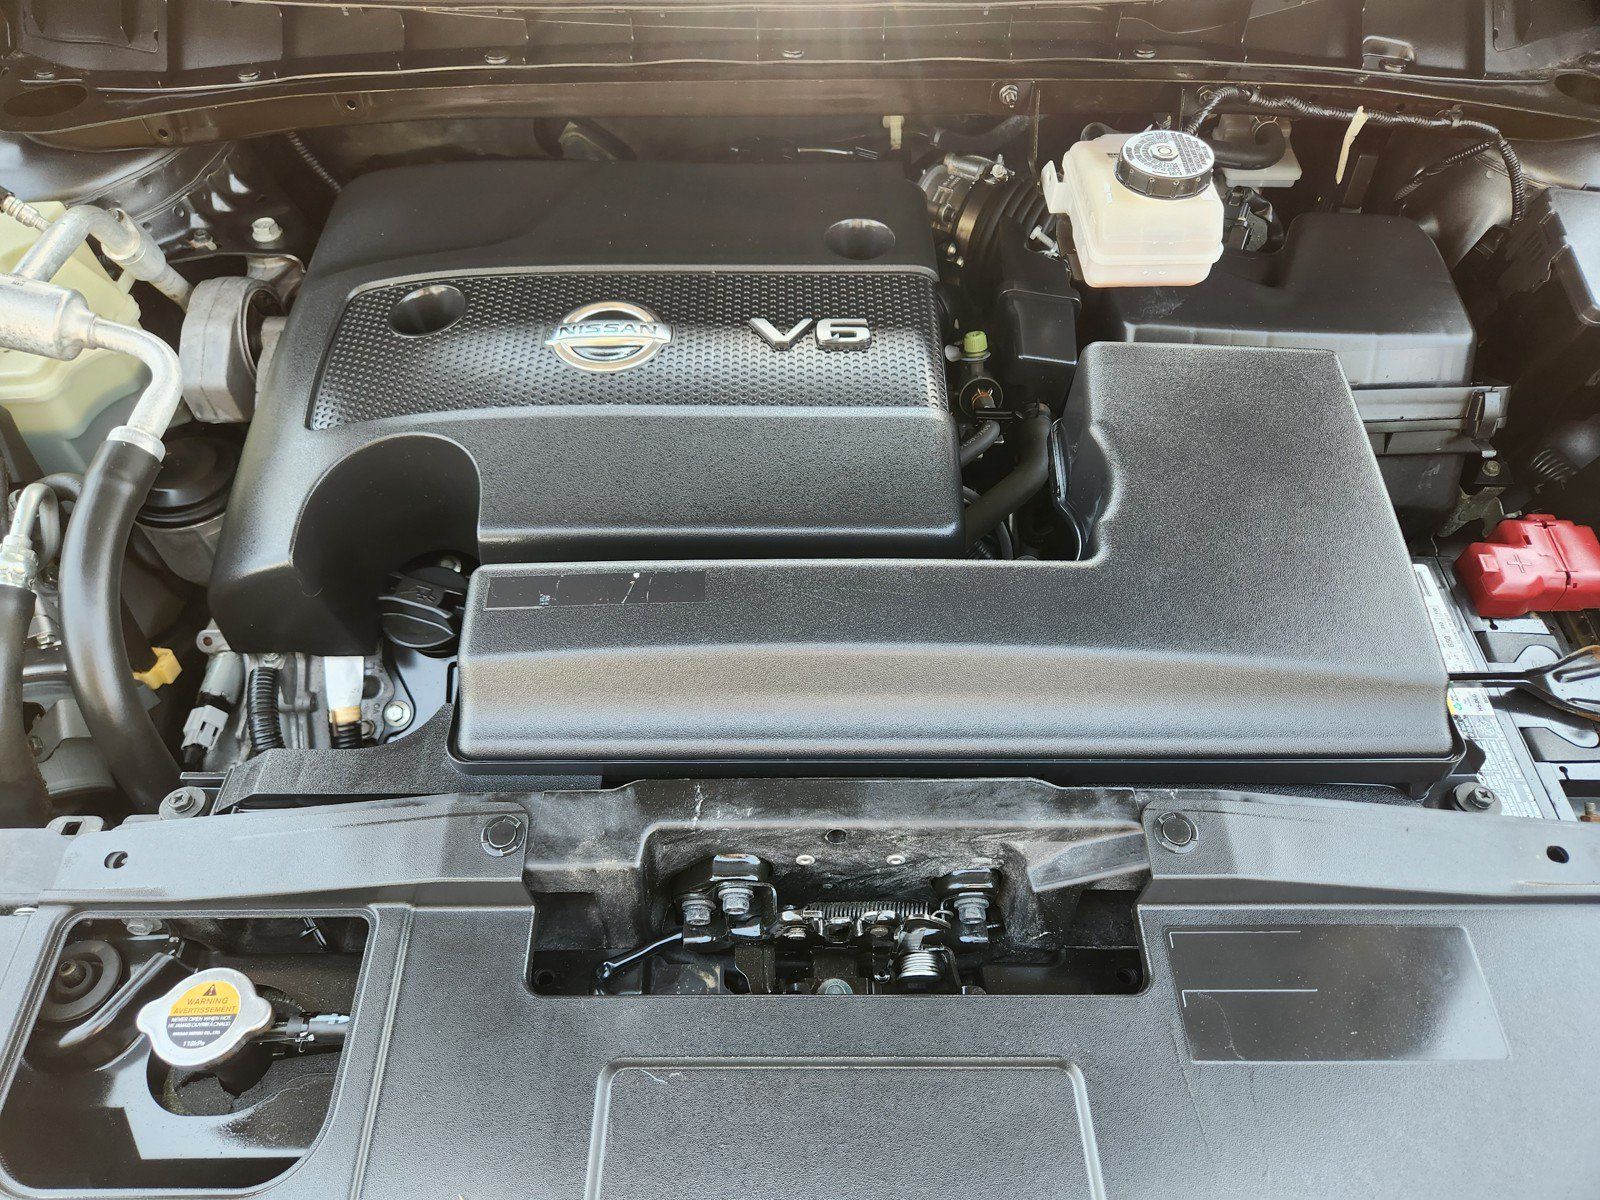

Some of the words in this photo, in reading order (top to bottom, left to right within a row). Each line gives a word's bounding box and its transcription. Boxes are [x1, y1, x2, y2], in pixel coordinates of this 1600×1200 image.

[558, 322, 657, 336] NISSAN
[748, 317, 873, 351] V6
[187, 997, 229, 1005] WARNING
[173, 1006, 236, 1014] AVERTISSEMENT
